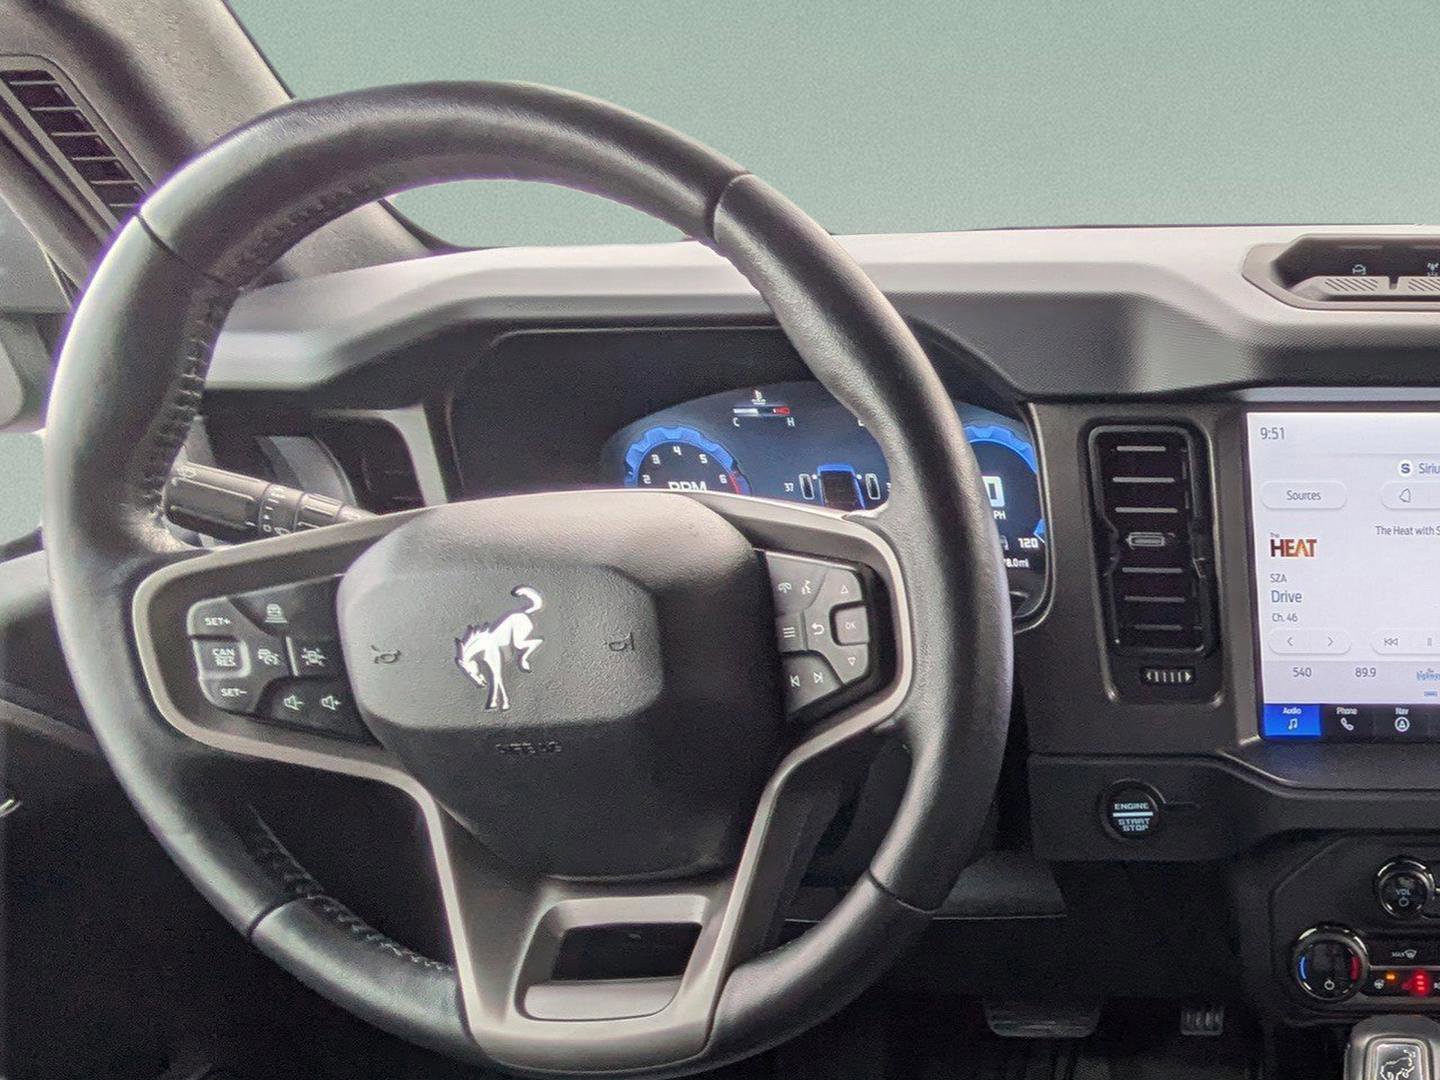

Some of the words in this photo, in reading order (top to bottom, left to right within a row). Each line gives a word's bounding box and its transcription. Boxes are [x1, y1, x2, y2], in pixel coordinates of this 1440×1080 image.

[787, 417, 795, 427] H
[1260, 427, 1285, 440] 9:51
[673, 446, 682, 456] 4
[651, 454, 661, 465] 3
[699, 454, 708, 464] 5
[642, 474, 651, 484] 2
[719, 474, 727, 484] 6
[1286, 490, 1322, 501] Sources
[993, 510, 1006, 520] PH
[1375, 525, 1392, 536] The
[1393, 525, 1414, 536] Heat
[1415, 525, 1435, 536] with
[1018, 538, 1039, 549] 120
[1270, 538, 1318, 558] HEAT
[1270, 573, 1288, 583] SZA
[1271, 590, 1303, 603] Drive
[204, 616, 231, 626] SET+
[1272, 612, 1285, 622] Ch.
[1286, 612, 1298, 622] 46
[1293, 667, 1312, 678] 540
[1355, 667, 1377, 678] 89.9
[1283, 707, 1302, 715] Audio
[1336, 707, 1358, 715] Phone
[1114, 802, 1149, 811] ENGINE
[1118, 817, 1150, 825] START
[1123, 824, 1149, 832] STOP
